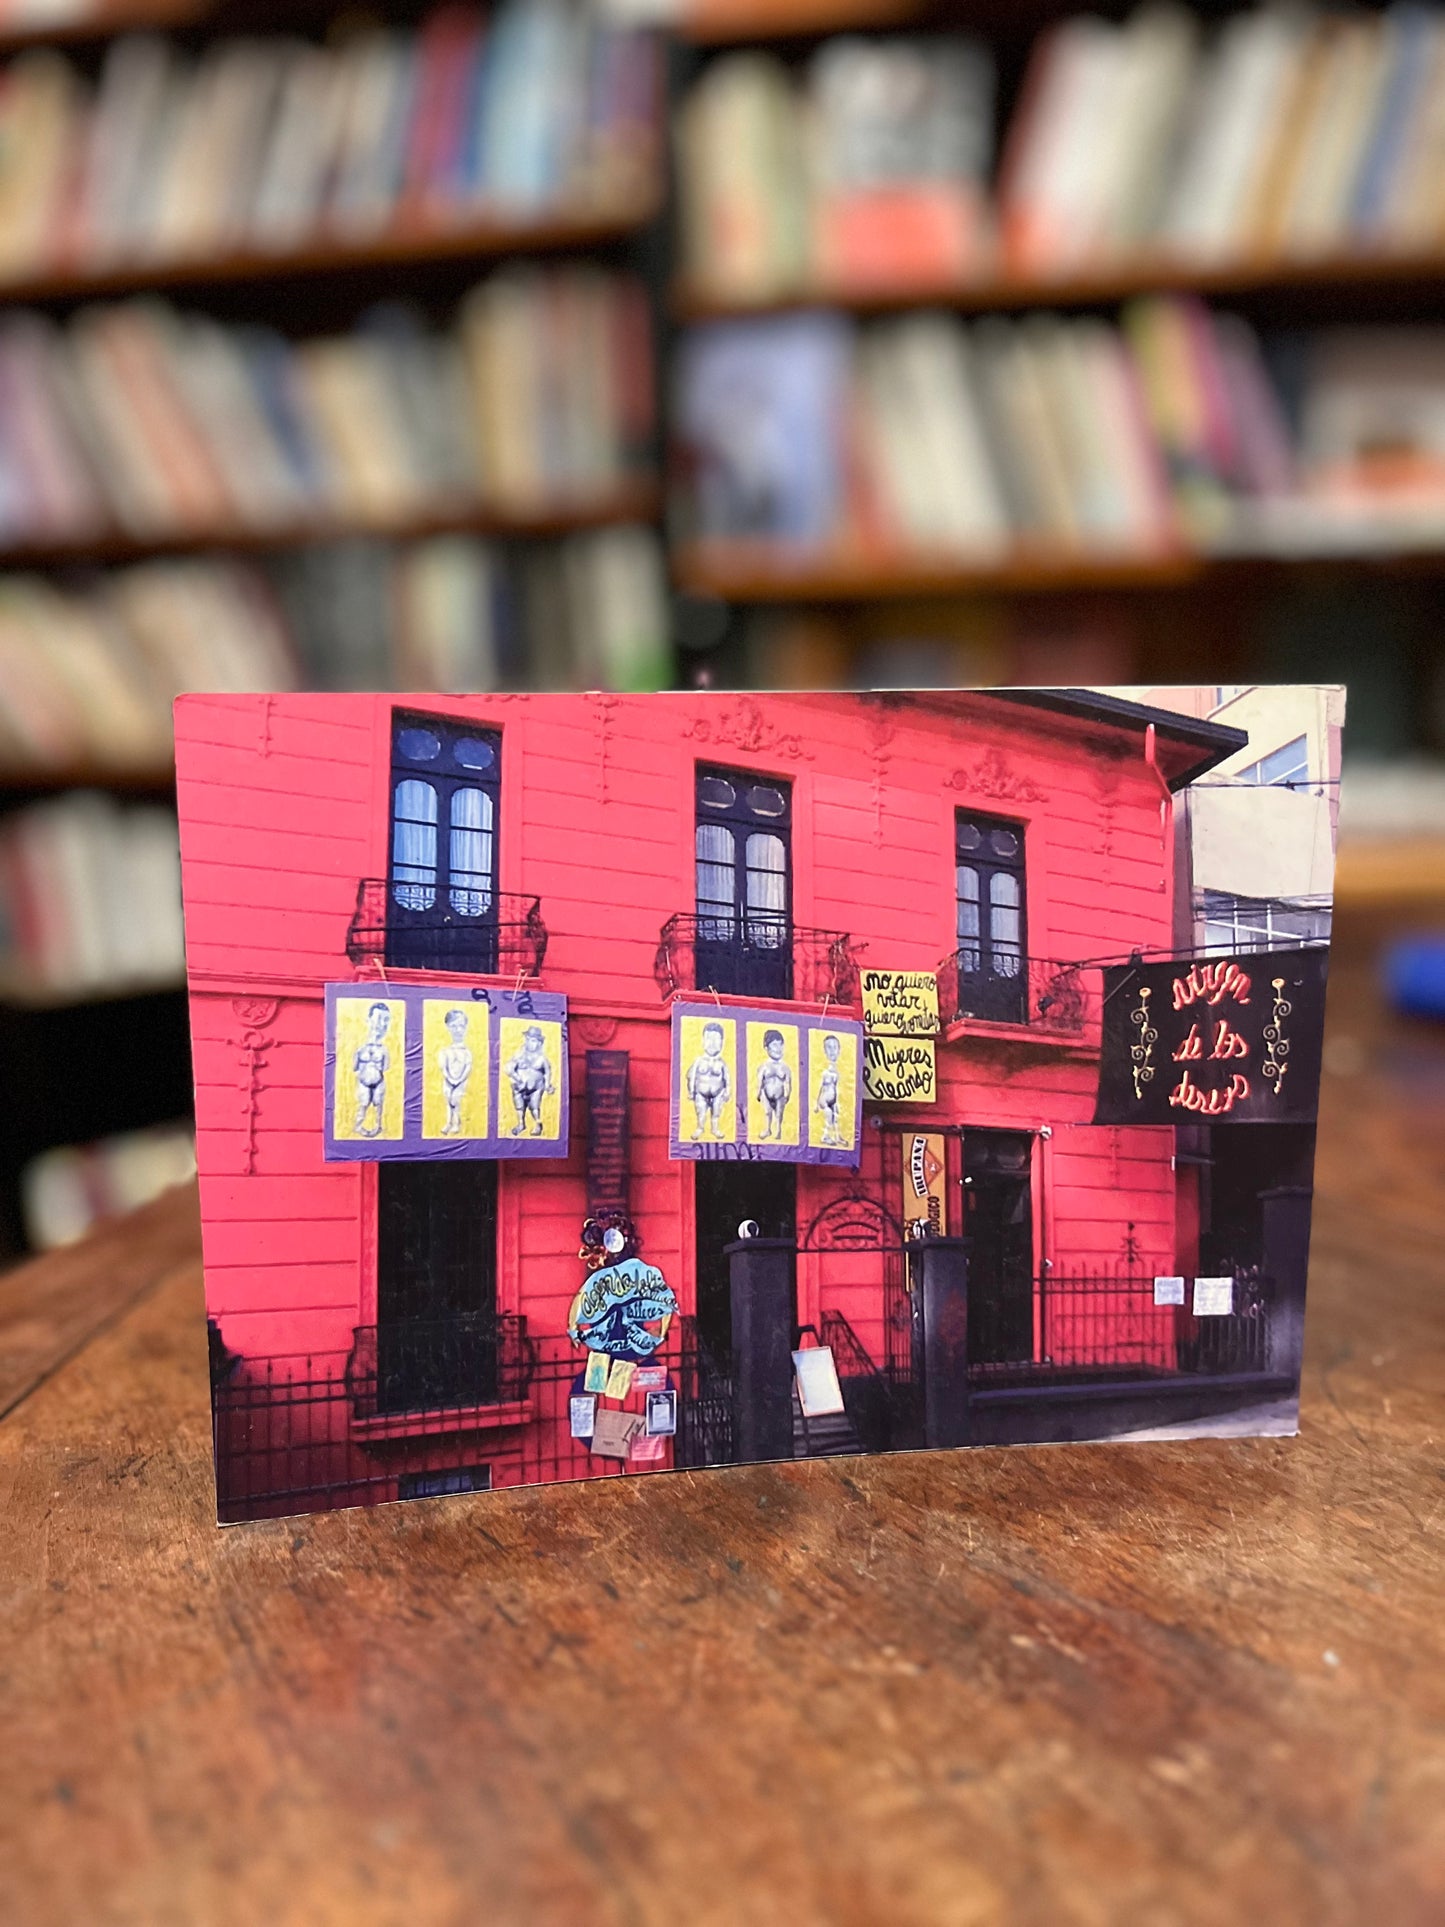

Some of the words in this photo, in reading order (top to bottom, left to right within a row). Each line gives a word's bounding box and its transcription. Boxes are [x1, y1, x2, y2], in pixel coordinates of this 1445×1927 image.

[895, 973, 937, 995] quiero
[864, 1008, 904, 1030] quiero
[863, 1037, 933, 1079] Mujeres
[1171, 1023, 1202, 1062] de
[862, 1065, 933, 1100] Creando
